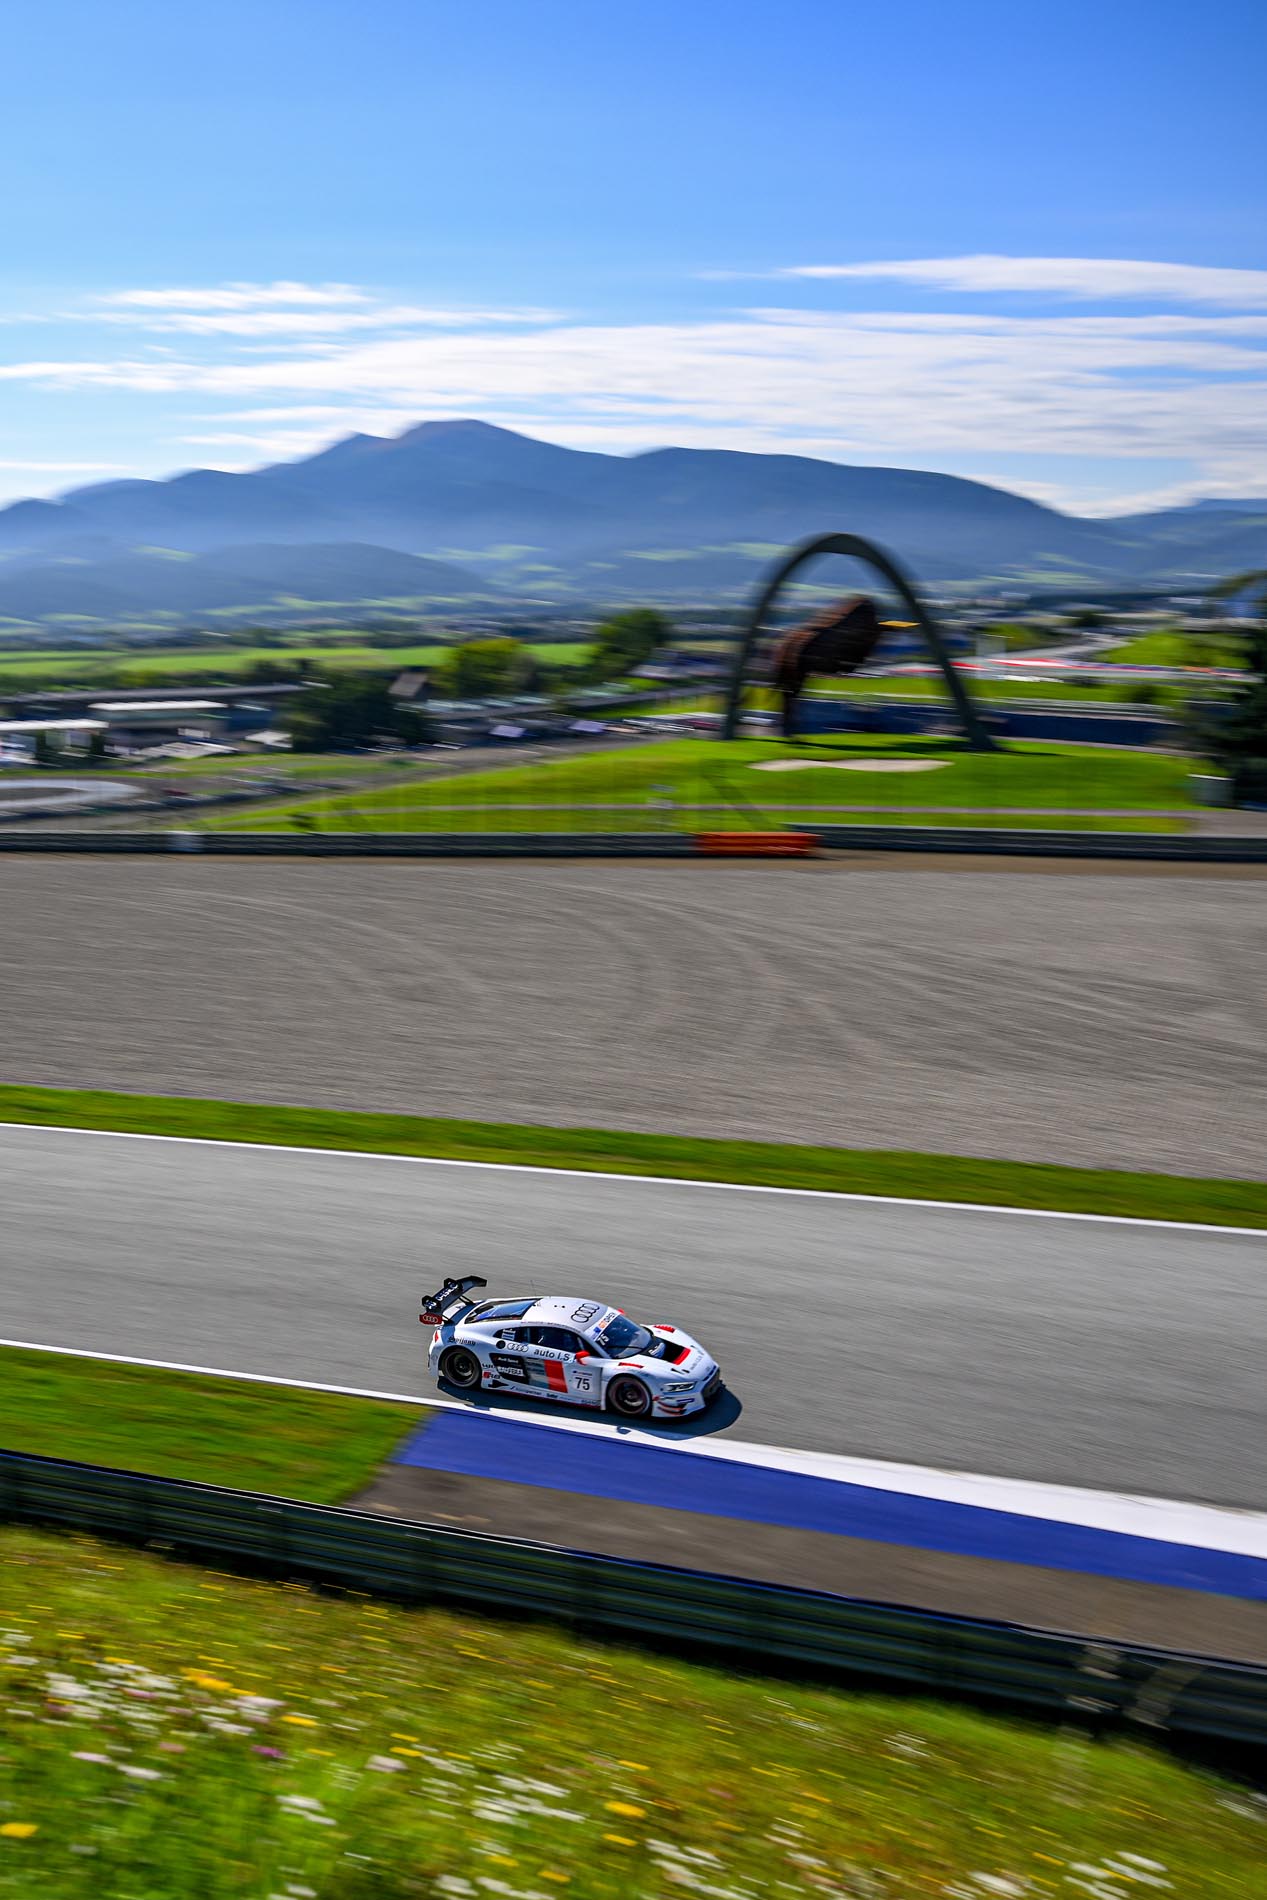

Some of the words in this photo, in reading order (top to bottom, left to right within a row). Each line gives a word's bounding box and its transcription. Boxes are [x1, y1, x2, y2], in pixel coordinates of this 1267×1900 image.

[597, 1333, 610, 1346] 75
[533, 1348, 556, 1359] auto
[574, 1376, 590, 1391] 75
